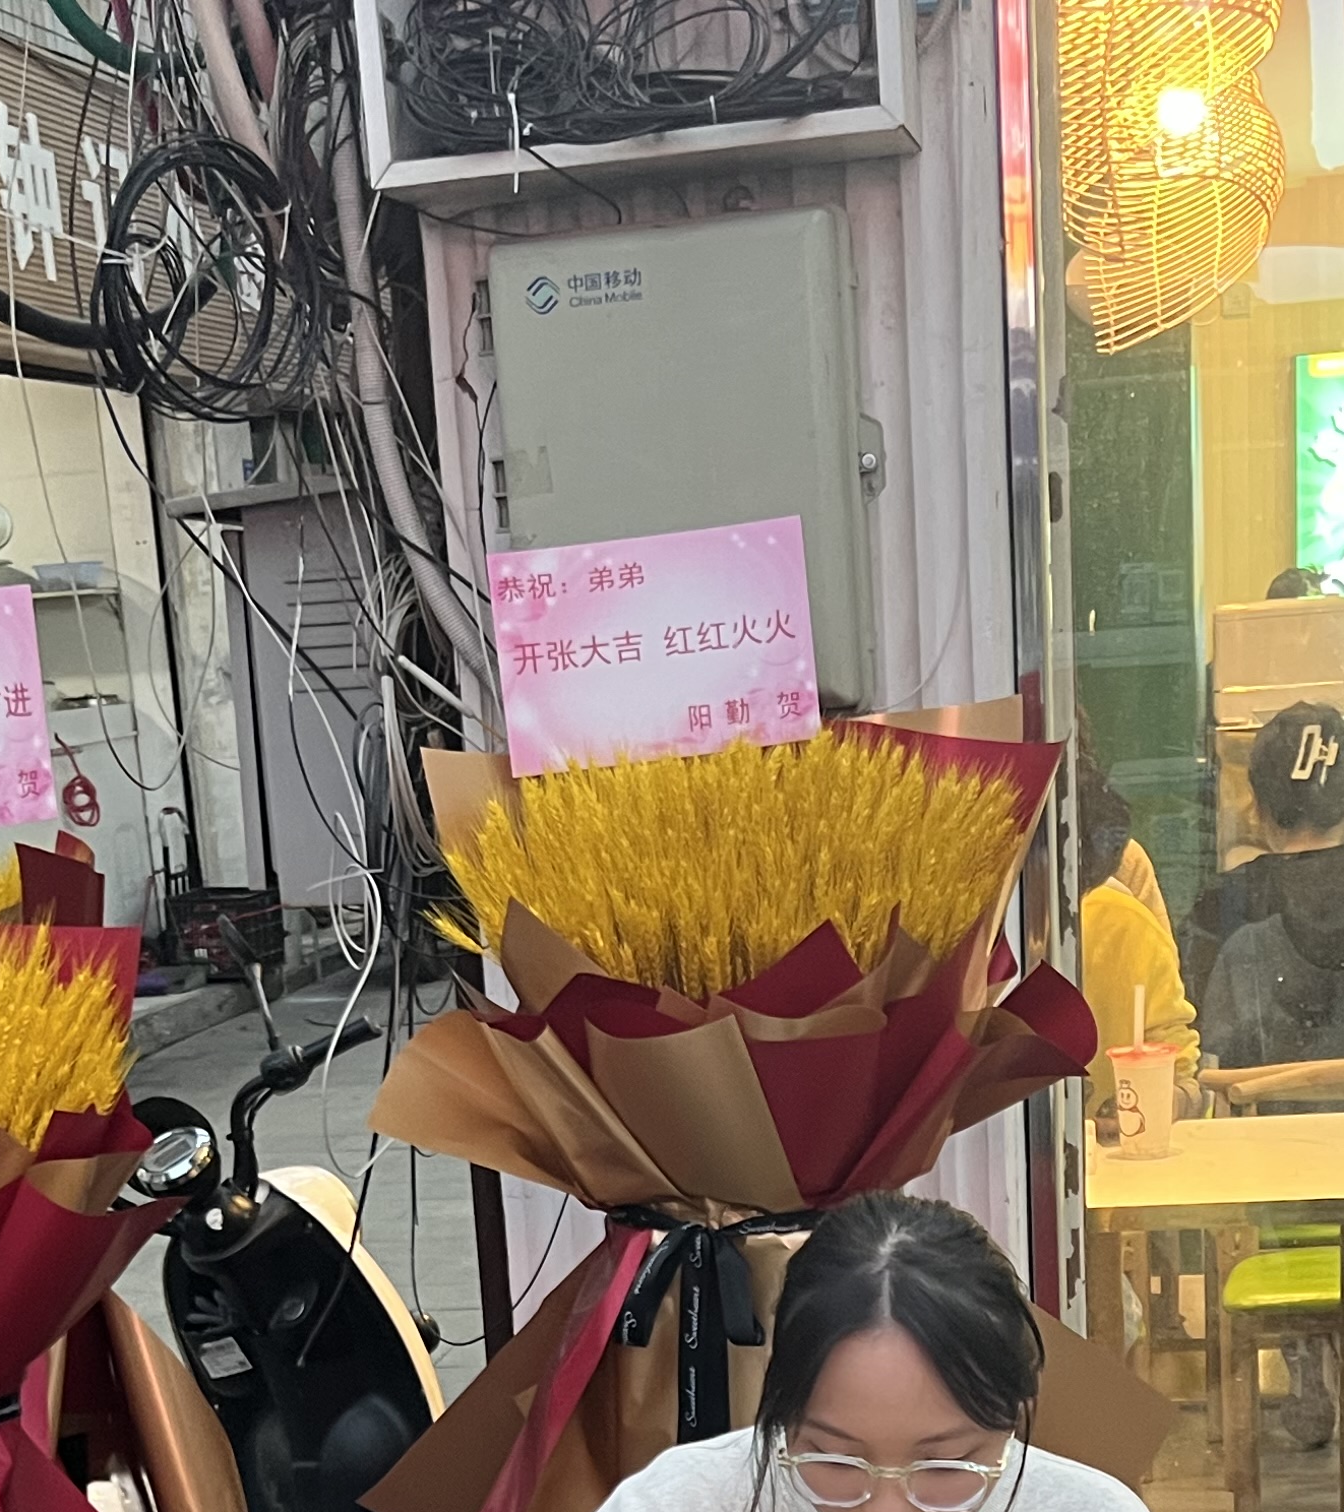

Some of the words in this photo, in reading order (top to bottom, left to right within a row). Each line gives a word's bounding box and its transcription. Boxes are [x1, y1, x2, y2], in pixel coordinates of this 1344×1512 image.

[567, 267, 642, 293] 中国移动
[568, 295, 603, 307] China
[604, 290, 643, 304] Mobile
[588, 562, 645, 594] 弟弟
[512, 630, 644, 676] 开张大吉
[663, 609, 797, 657] 红红火火
